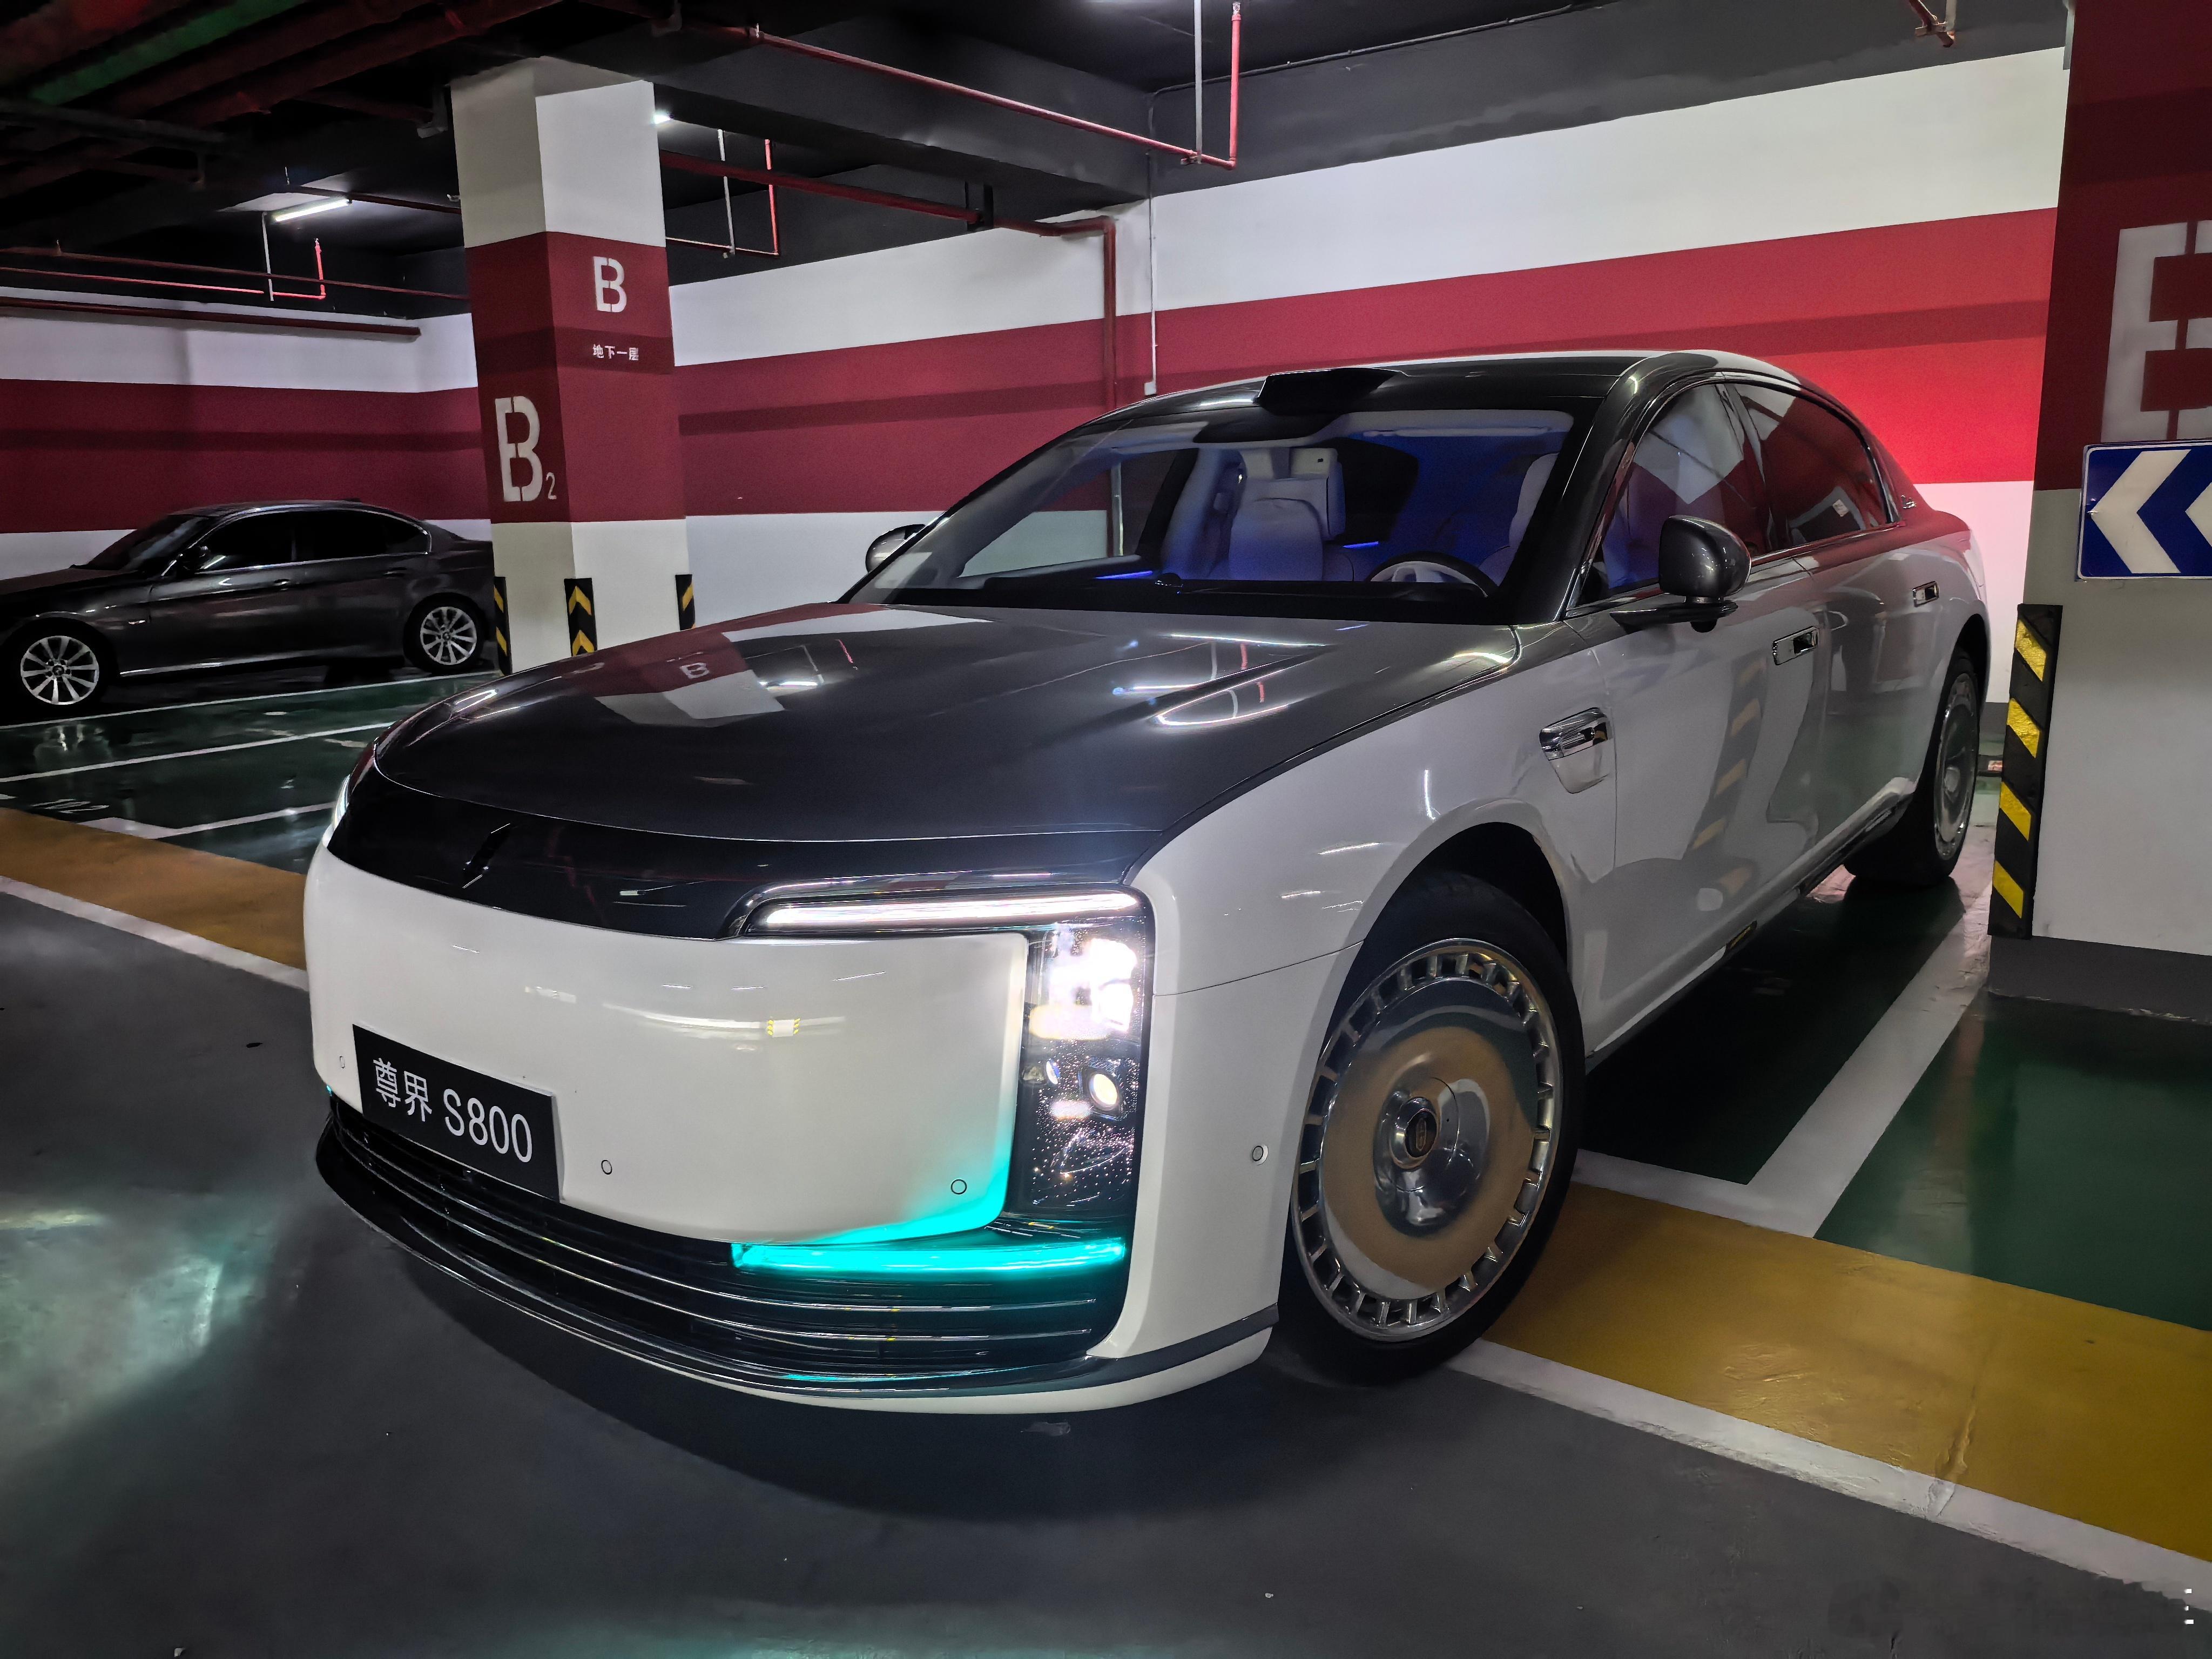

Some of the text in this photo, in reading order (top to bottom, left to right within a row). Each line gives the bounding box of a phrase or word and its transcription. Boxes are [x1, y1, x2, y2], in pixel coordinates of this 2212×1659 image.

[593, 256, 627, 312] B
[592, 344, 639, 361] 地下一层
[373, 1057, 532, 1163] 尊界 S800
